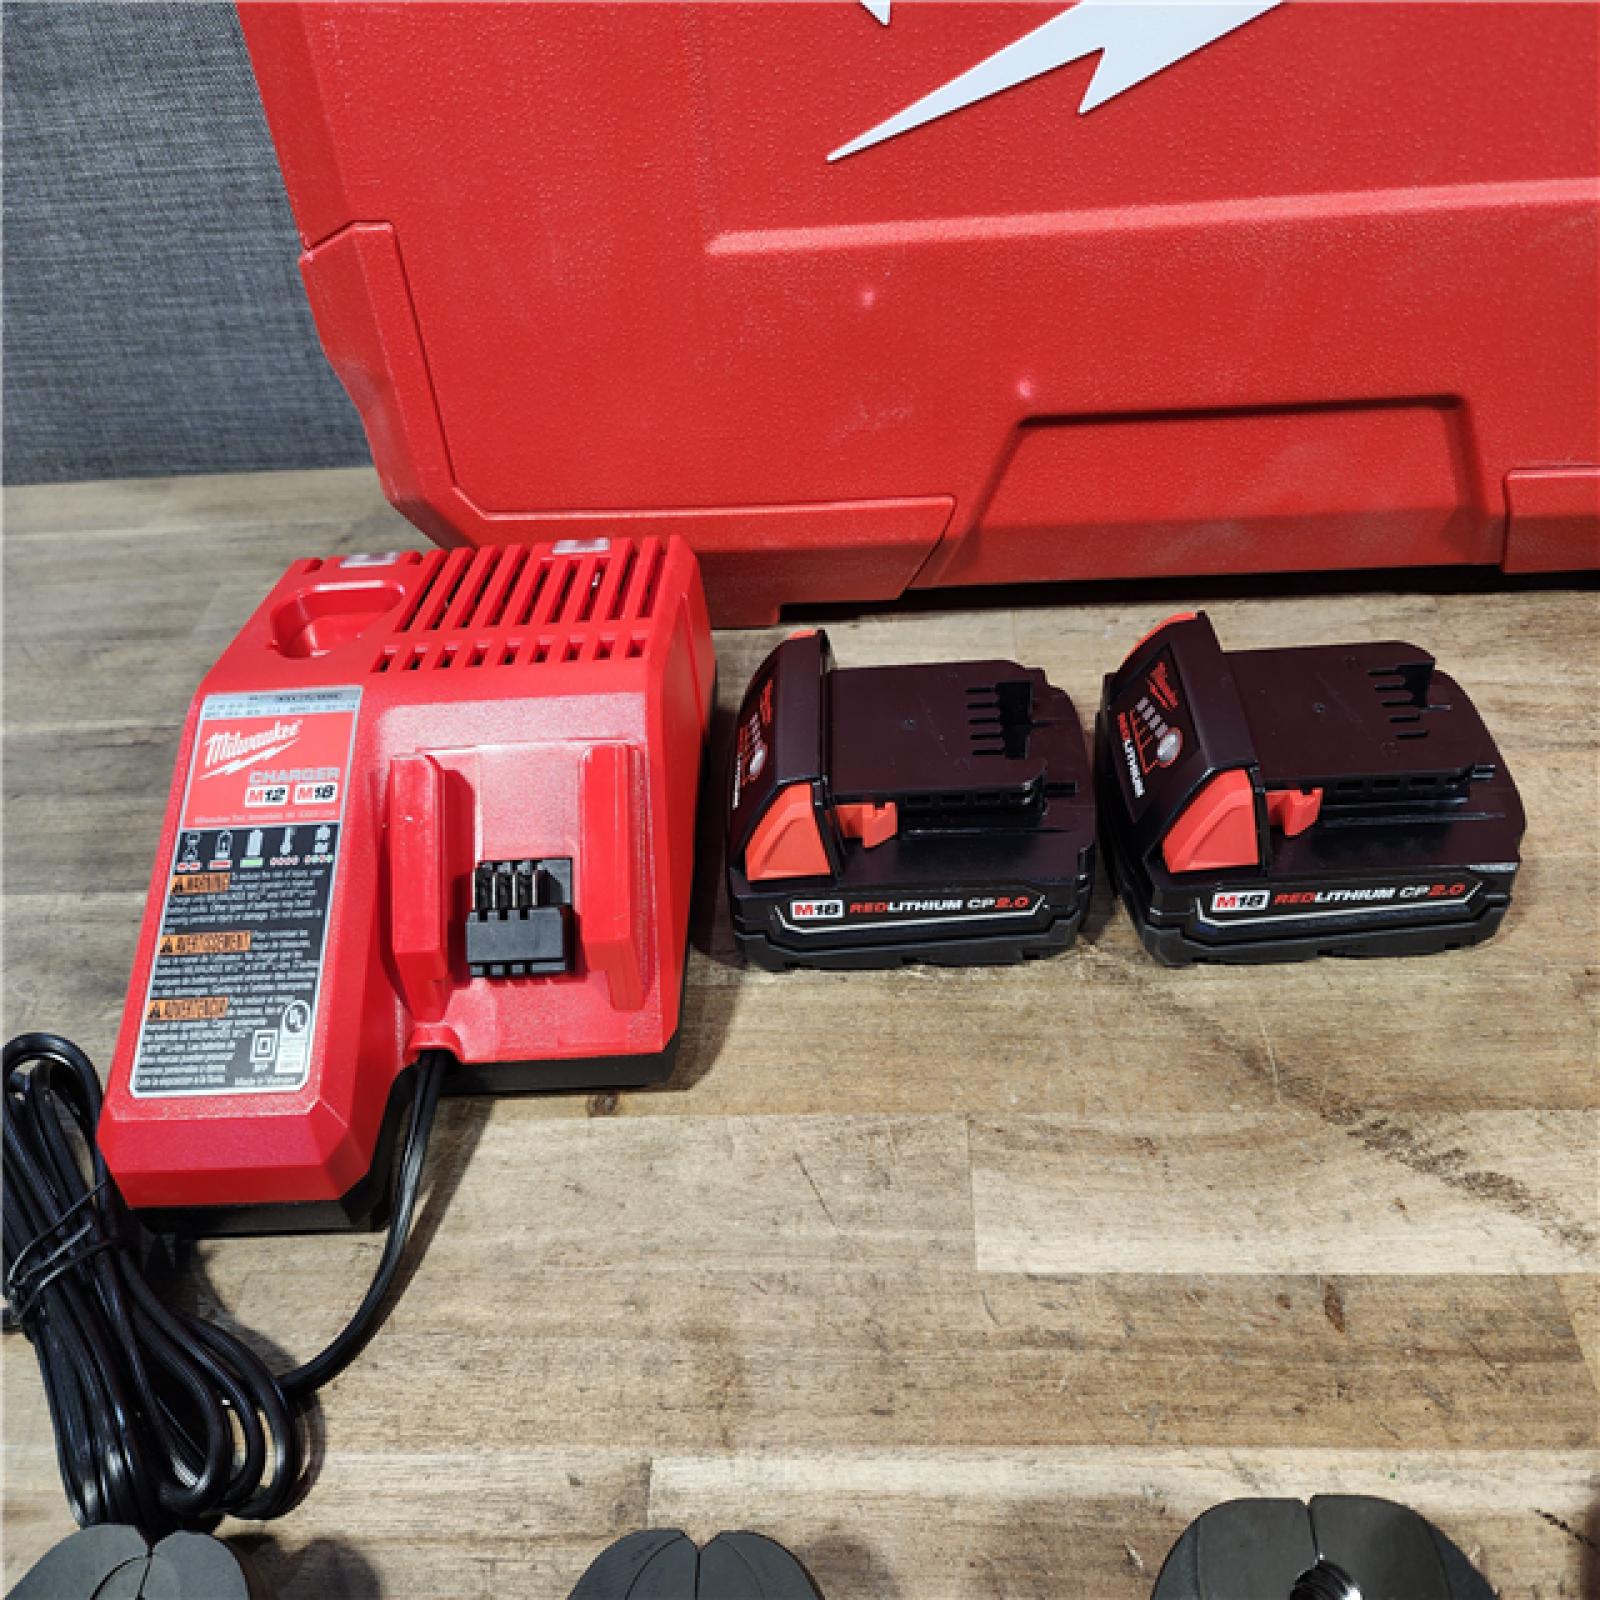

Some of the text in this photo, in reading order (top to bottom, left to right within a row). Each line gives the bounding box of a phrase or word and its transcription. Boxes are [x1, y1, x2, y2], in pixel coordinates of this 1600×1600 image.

[204, 720, 301, 768] Milwaukee
[249, 768, 340, 785] CHARGER
[248, 784, 337, 804] M12 M18
[794, 895, 1030, 916] M18 REDLITHIUM CP2.0
[1216, 883, 1466, 909] M18 REDLITHIUM CP2.0
